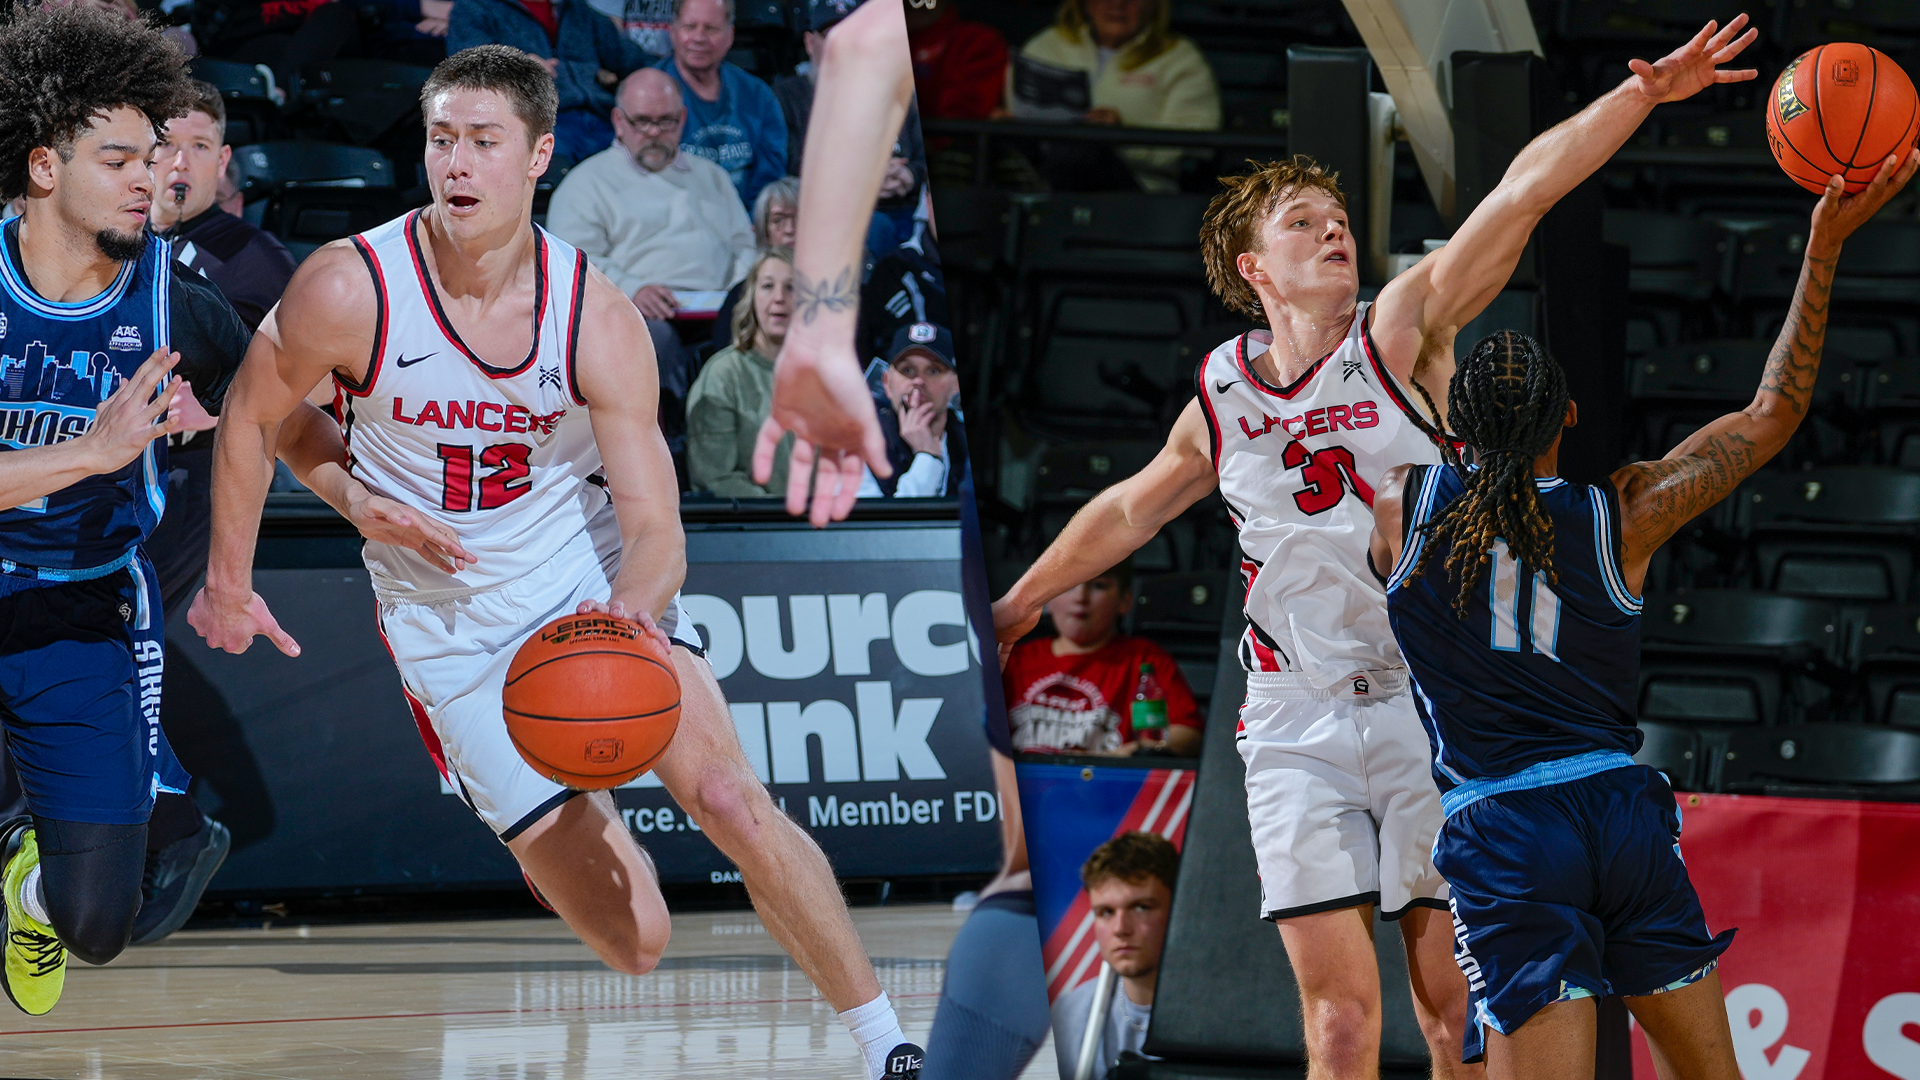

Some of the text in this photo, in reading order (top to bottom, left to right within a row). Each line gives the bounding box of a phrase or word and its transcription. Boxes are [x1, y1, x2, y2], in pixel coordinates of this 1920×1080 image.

[115, 325, 138, 337] AAC
[1238, 400, 1379, 440] LACERS
[437, 442, 533, 513] 12
[1805, 481, 1821, 501] 7
[1486, 536, 1561, 662] 11
[1673, 603, 1689, 623] 7
[680, 589, 985, 680] ourc
[808, 792, 944, 828] Member
